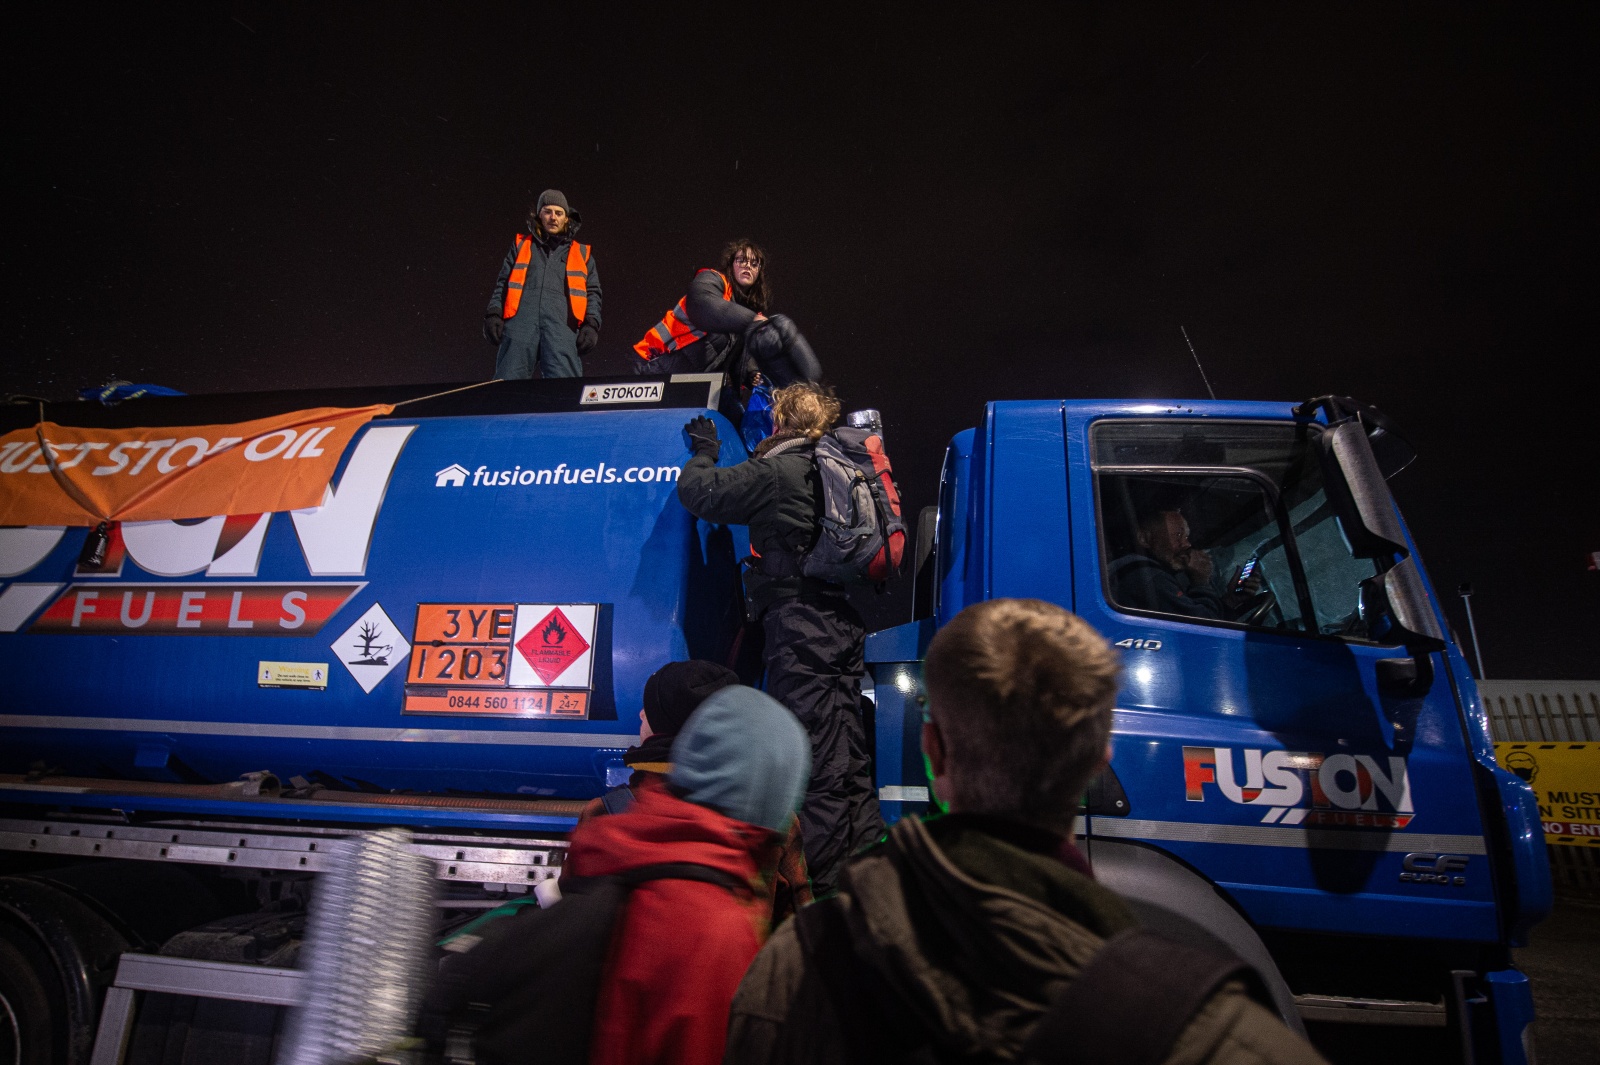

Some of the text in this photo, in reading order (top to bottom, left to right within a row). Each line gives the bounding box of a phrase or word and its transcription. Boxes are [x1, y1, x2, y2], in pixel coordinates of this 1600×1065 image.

[602, 385, 659, 399] STOKOTA
[243, 426, 336, 462] OIL
[472, 462, 682, 487] fusionfuels.com
[71, 591, 309, 629] FUELS
[443, 609, 514, 639] 3YE
[531, 649, 571, 657] FLAMMABLE
[1114, 638, 1163, 651] 410
[417, 649, 506, 680] 1203
[449, 695, 544, 711] 0844 560 1124
[558, 700, 579, 710] 24-7
[1181, 745, 1415, 812] FUSION
[1317, 813, 1401, 829] FUELS
[1403, 852, 1470, 873] CF
[1399, 872, 1450, 885] EURO
